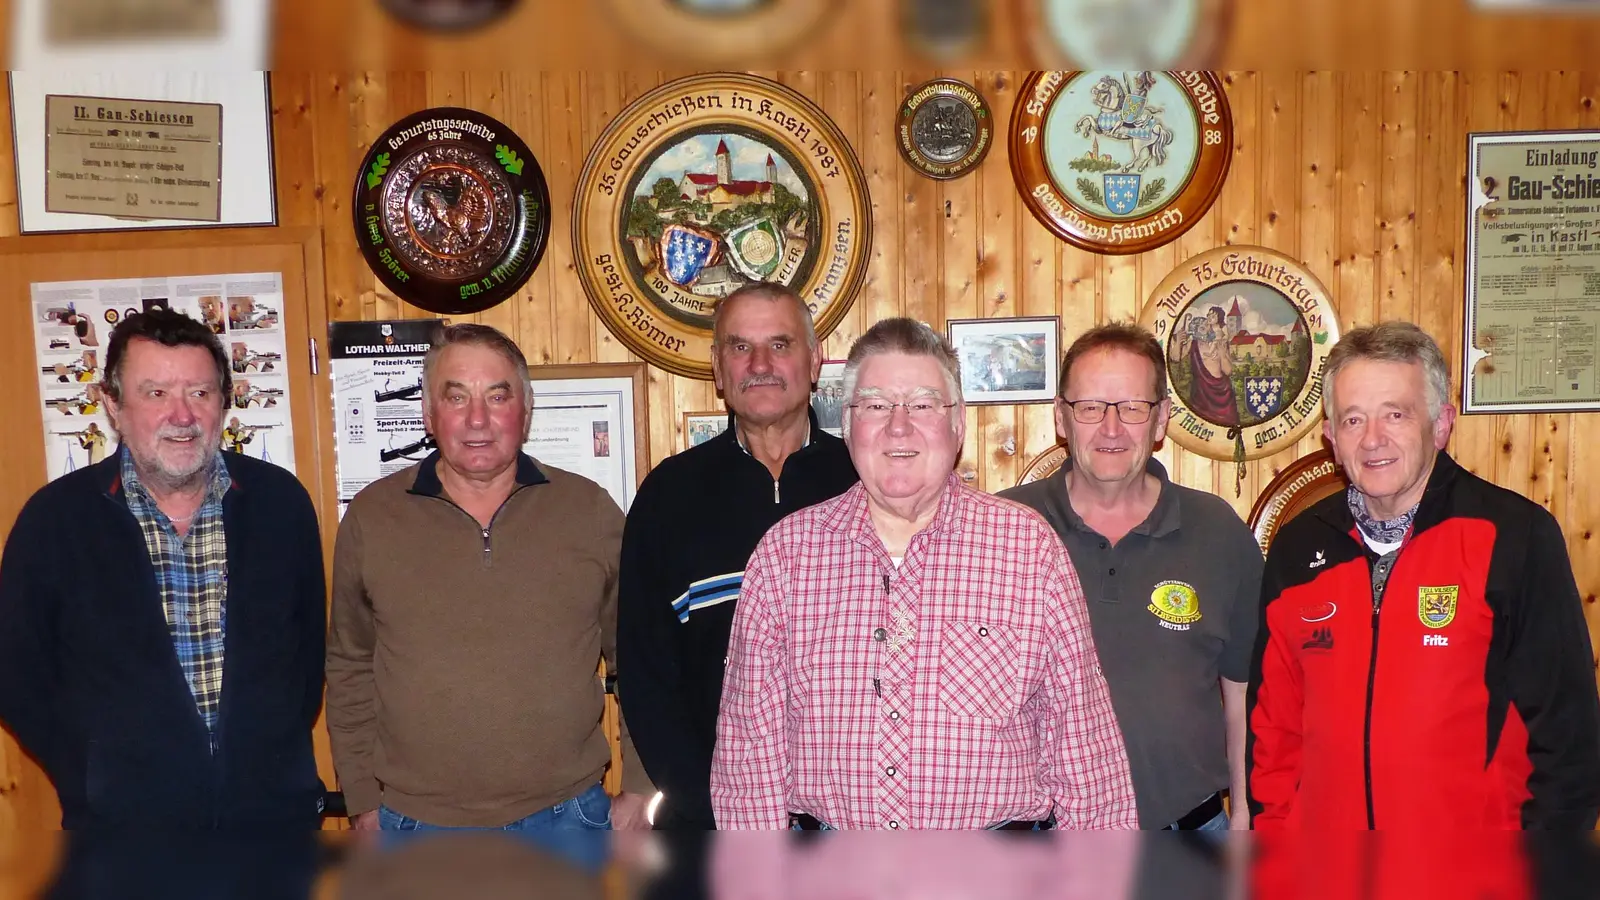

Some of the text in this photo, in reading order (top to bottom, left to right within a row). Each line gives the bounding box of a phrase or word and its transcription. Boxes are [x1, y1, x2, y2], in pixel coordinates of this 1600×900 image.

[74, 106, 90, 119] II.
[388, 119, 496, 150] Geburtstagsscheibe
[427, 130, 462, 141] 65 Jahre
[598, 92, 841, 195] 35. Gauschießen in Kastl 1987
[1021, 126, 1038, 144] 19
[1205, 130, 1222, 146] 88
[1525, 149, 1598, 169] Einladung
[1108, 207, 1183, 244] Heinrich
[1483, 221, 1559, 231] Volksbelustigungen
[834, 218, 851, 255] sen.
[1531, 229, 1588, 242] in Kastl
[379, 246, 410, 282] Spörer
[1192, 263, 1218, 284] 75.
[1220, 252, 1319, 314] Geburtstag
[652, 277, 706, 312] 100 JAHRE
[626, 306, 686, 353] Römer
[1153, 319, 1167, 336] 19
[1308, 313, 1323, 328] 91
[345, 344, 431, 354] LOTHAR WALTHER
[1179, 412, 1214, 442] Meier
[1423, 634, 1449, 646] Fritz
